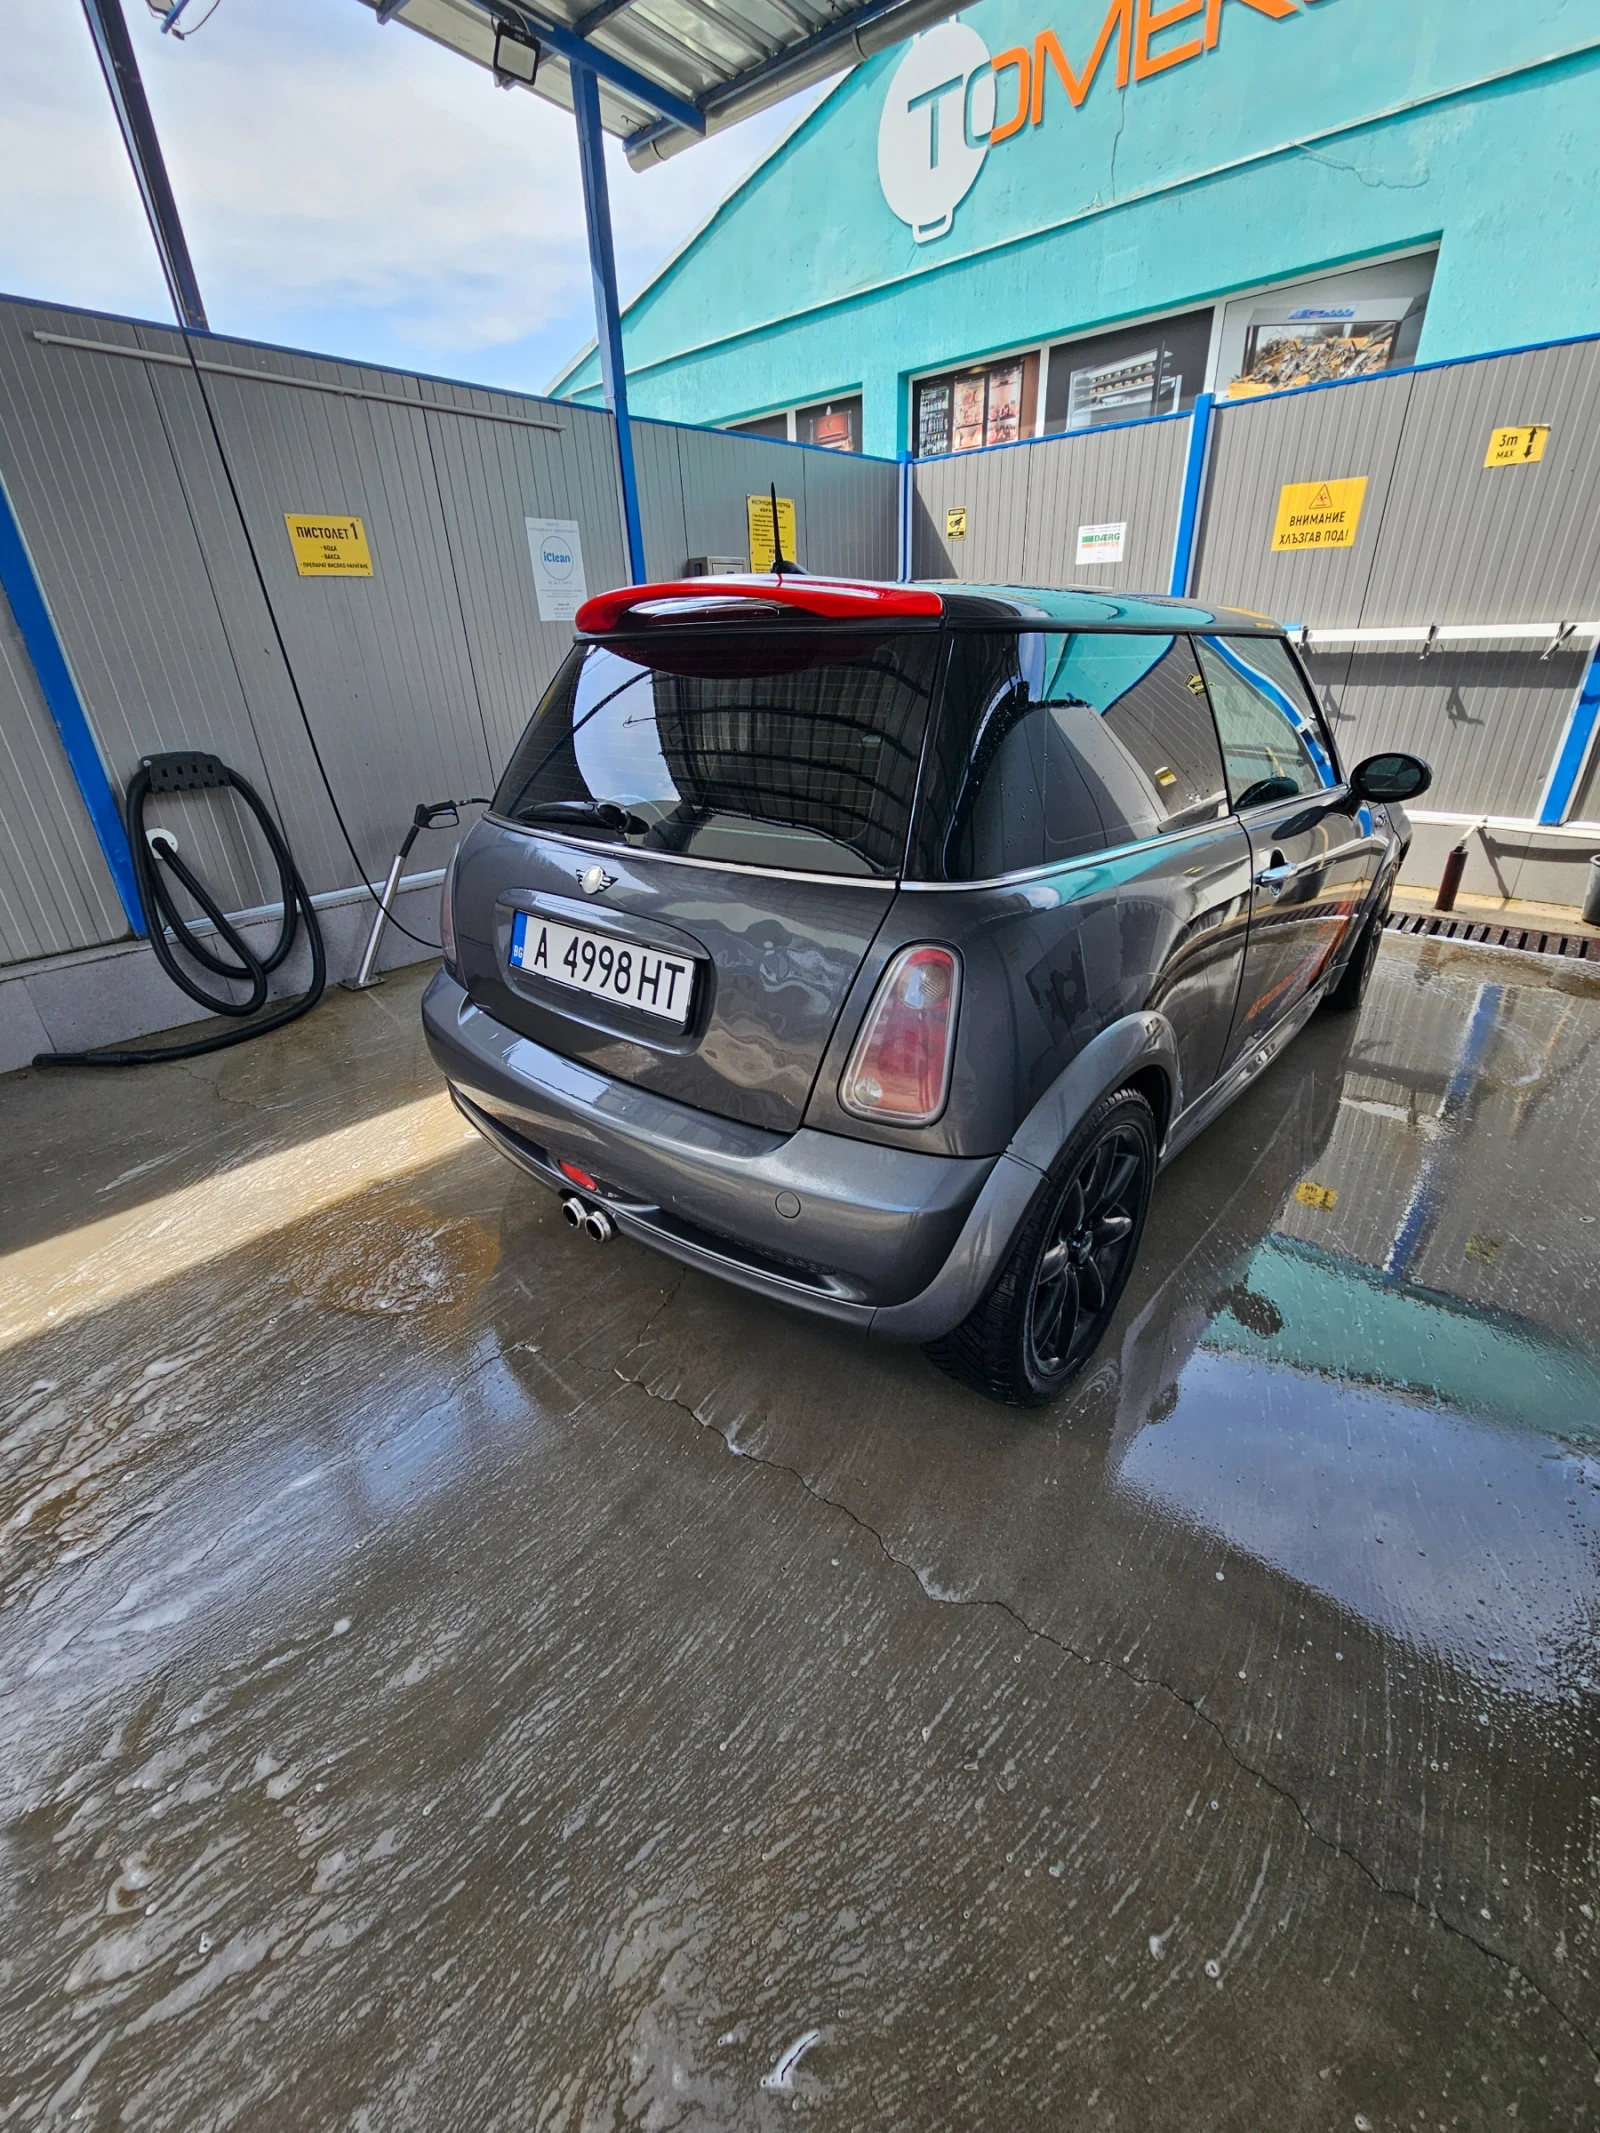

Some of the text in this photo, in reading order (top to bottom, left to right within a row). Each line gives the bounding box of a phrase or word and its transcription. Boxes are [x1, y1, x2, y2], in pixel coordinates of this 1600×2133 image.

[907, 0, 1318, 170] TOME
[1496, 450, 1515, 459] MAX
[1289, 511, 1346, 527] ВНИМАНИЕ
[296, 522, 358, 540] ПИСТОЛЕТ 1
[1279, 529, 1349, 545] ХЛЪЗГАВ ПОД!
[543, 551, 571, 563] iClean
[513, 945, 523, 959] BG
[534, 927, 547, 969] A
